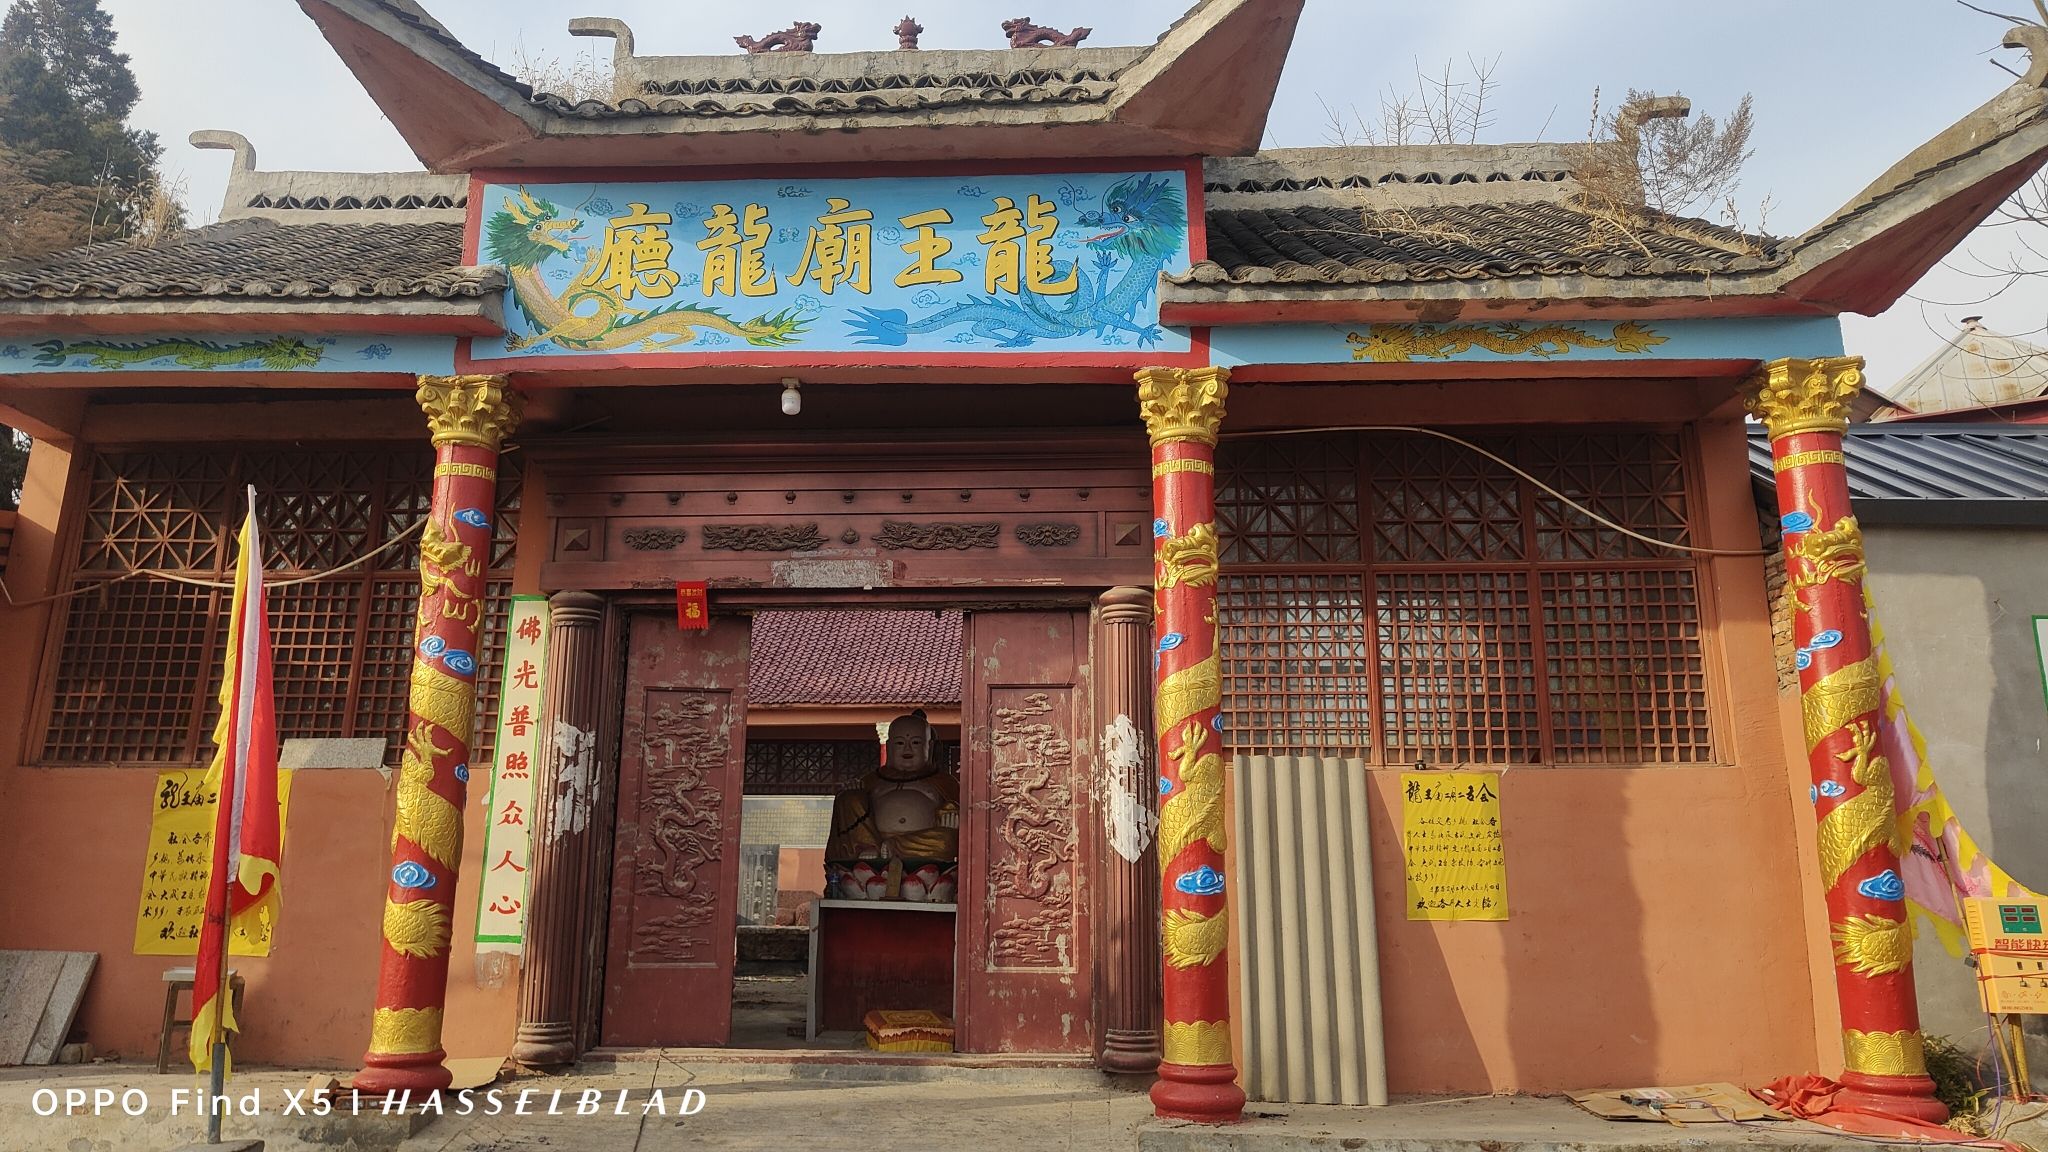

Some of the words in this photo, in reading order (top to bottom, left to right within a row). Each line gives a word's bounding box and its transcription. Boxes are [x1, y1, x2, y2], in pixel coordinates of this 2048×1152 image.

[685, 602, 701, 619] 福
[488, 615, 542, 915] 佛光普照众人心
